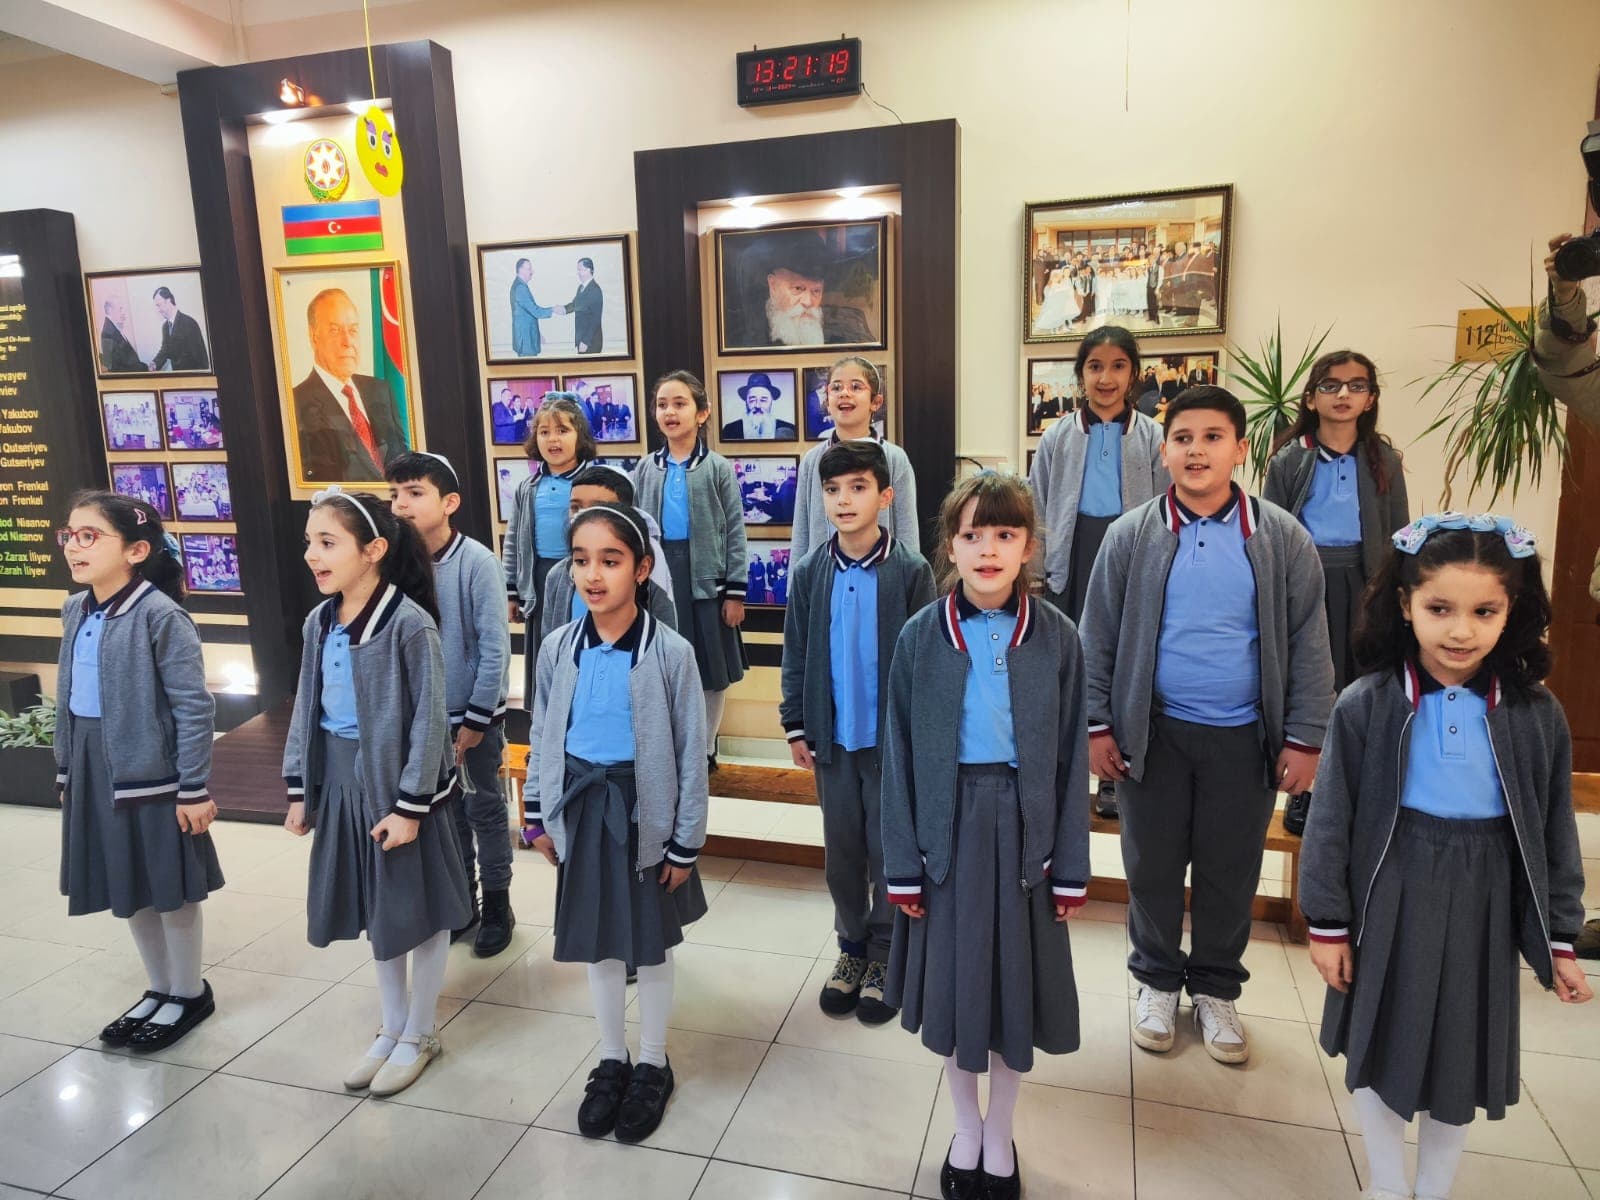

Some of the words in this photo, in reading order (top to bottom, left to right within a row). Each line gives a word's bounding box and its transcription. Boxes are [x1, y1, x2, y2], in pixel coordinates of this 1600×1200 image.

[753, 49, 850, 83] 13:21:19
[1, 408, 39, 419] Yakubov
[0, 457, 45, 470] Gutseriyev
[16, 517, 51, 528] Nisanov
[10, 531, 44, 542] Nisanov
